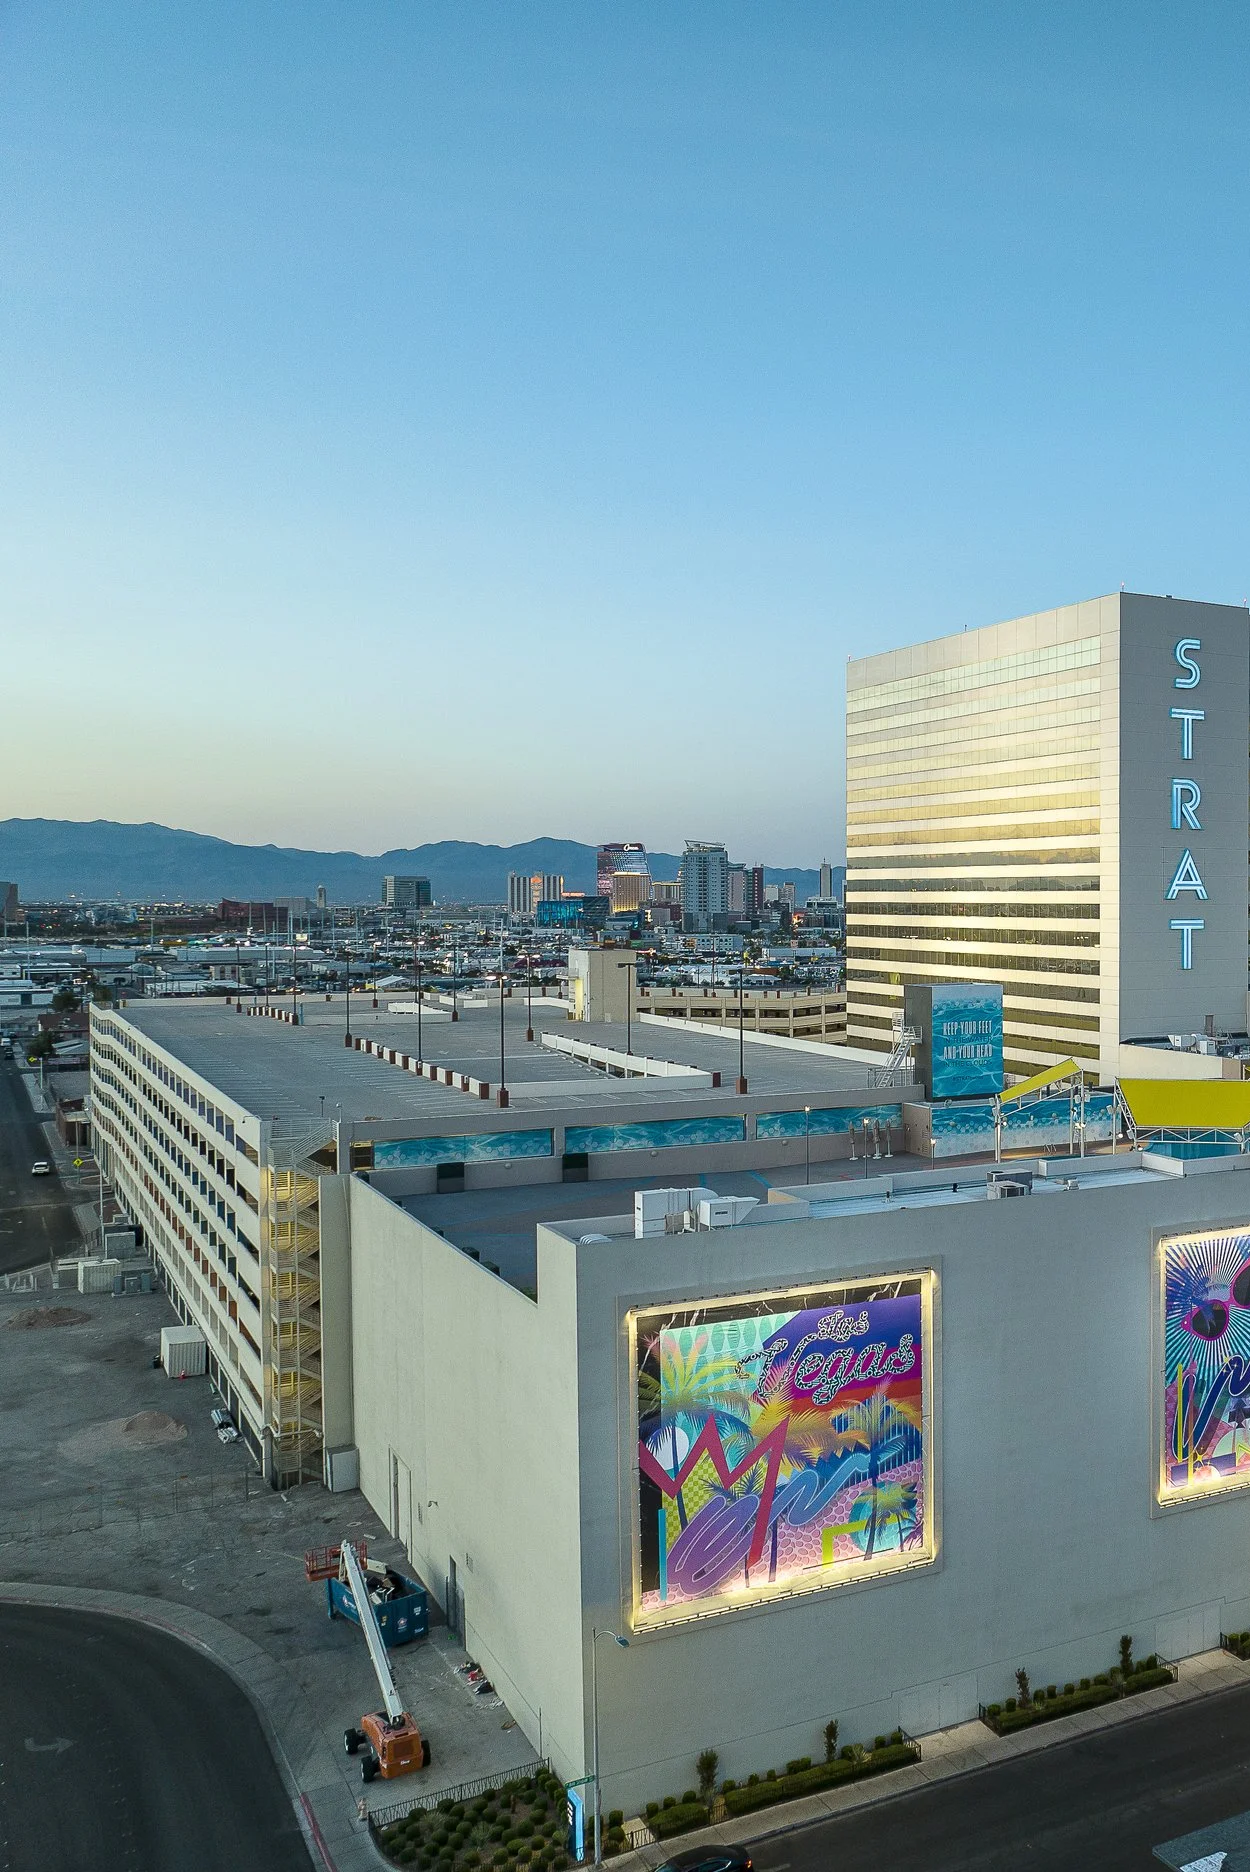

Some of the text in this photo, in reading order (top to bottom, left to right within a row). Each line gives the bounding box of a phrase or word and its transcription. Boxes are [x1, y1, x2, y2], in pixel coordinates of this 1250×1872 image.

[1165, 637, 1209, 970] STRAT
[943, 1020, 992, 1035] KEEP YOUR FEET
[943, 1044, 992, 1059] AND YOUR HEAD
[818, 1310, 869, 1342] Las
[734, 1333, 915, 1406] Vegas
